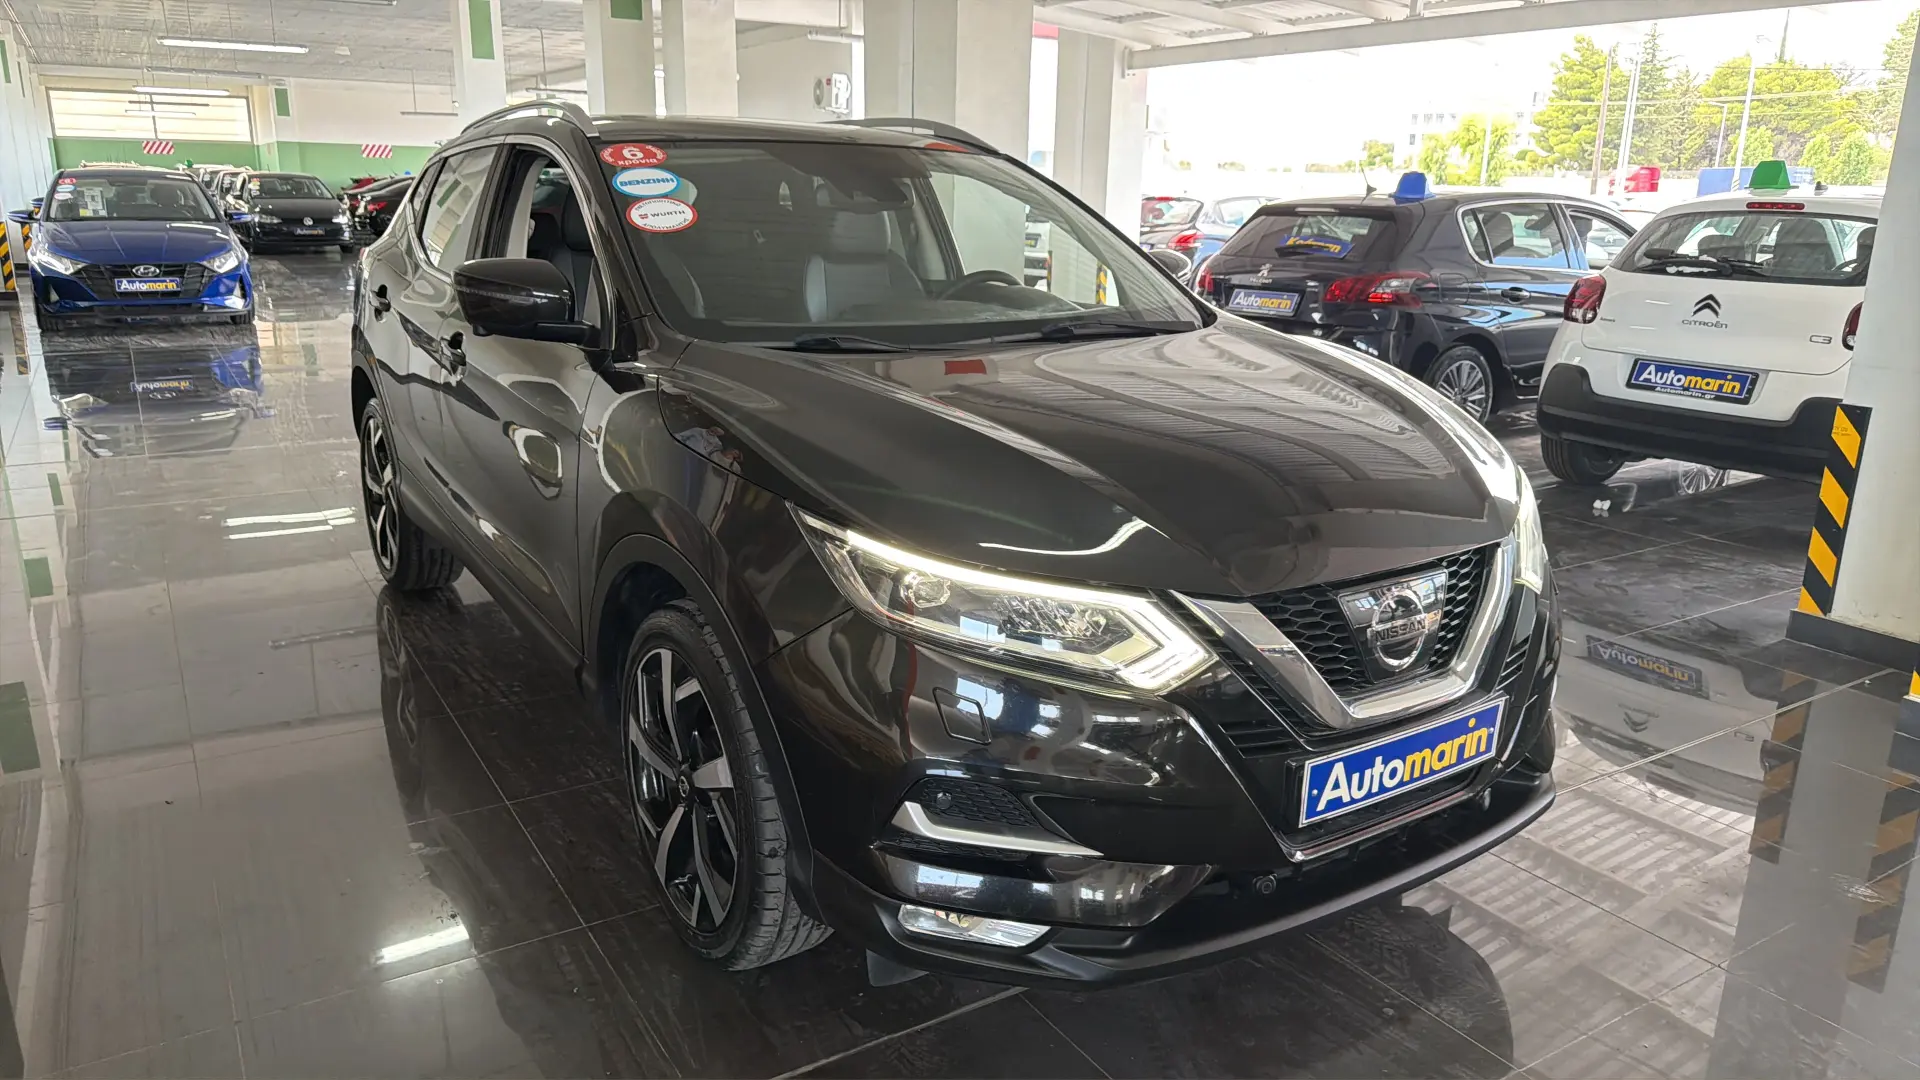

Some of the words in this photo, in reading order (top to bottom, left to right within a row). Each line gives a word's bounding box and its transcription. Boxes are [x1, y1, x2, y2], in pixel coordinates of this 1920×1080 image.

[622, 147, 644, 160] 6
[120, 279, 177, 290] Automarin
[1233, 291, 1292, 308] Automarin
[1809, 334, 1833, 345] C3
[1638, 364, 1742, 395] Automarin
[1655, 386, 1716, 399] Automarin.gr
[1375, 618, 1427, 642] NISSAN
[1315, 717, 1489, 812] Automarin
